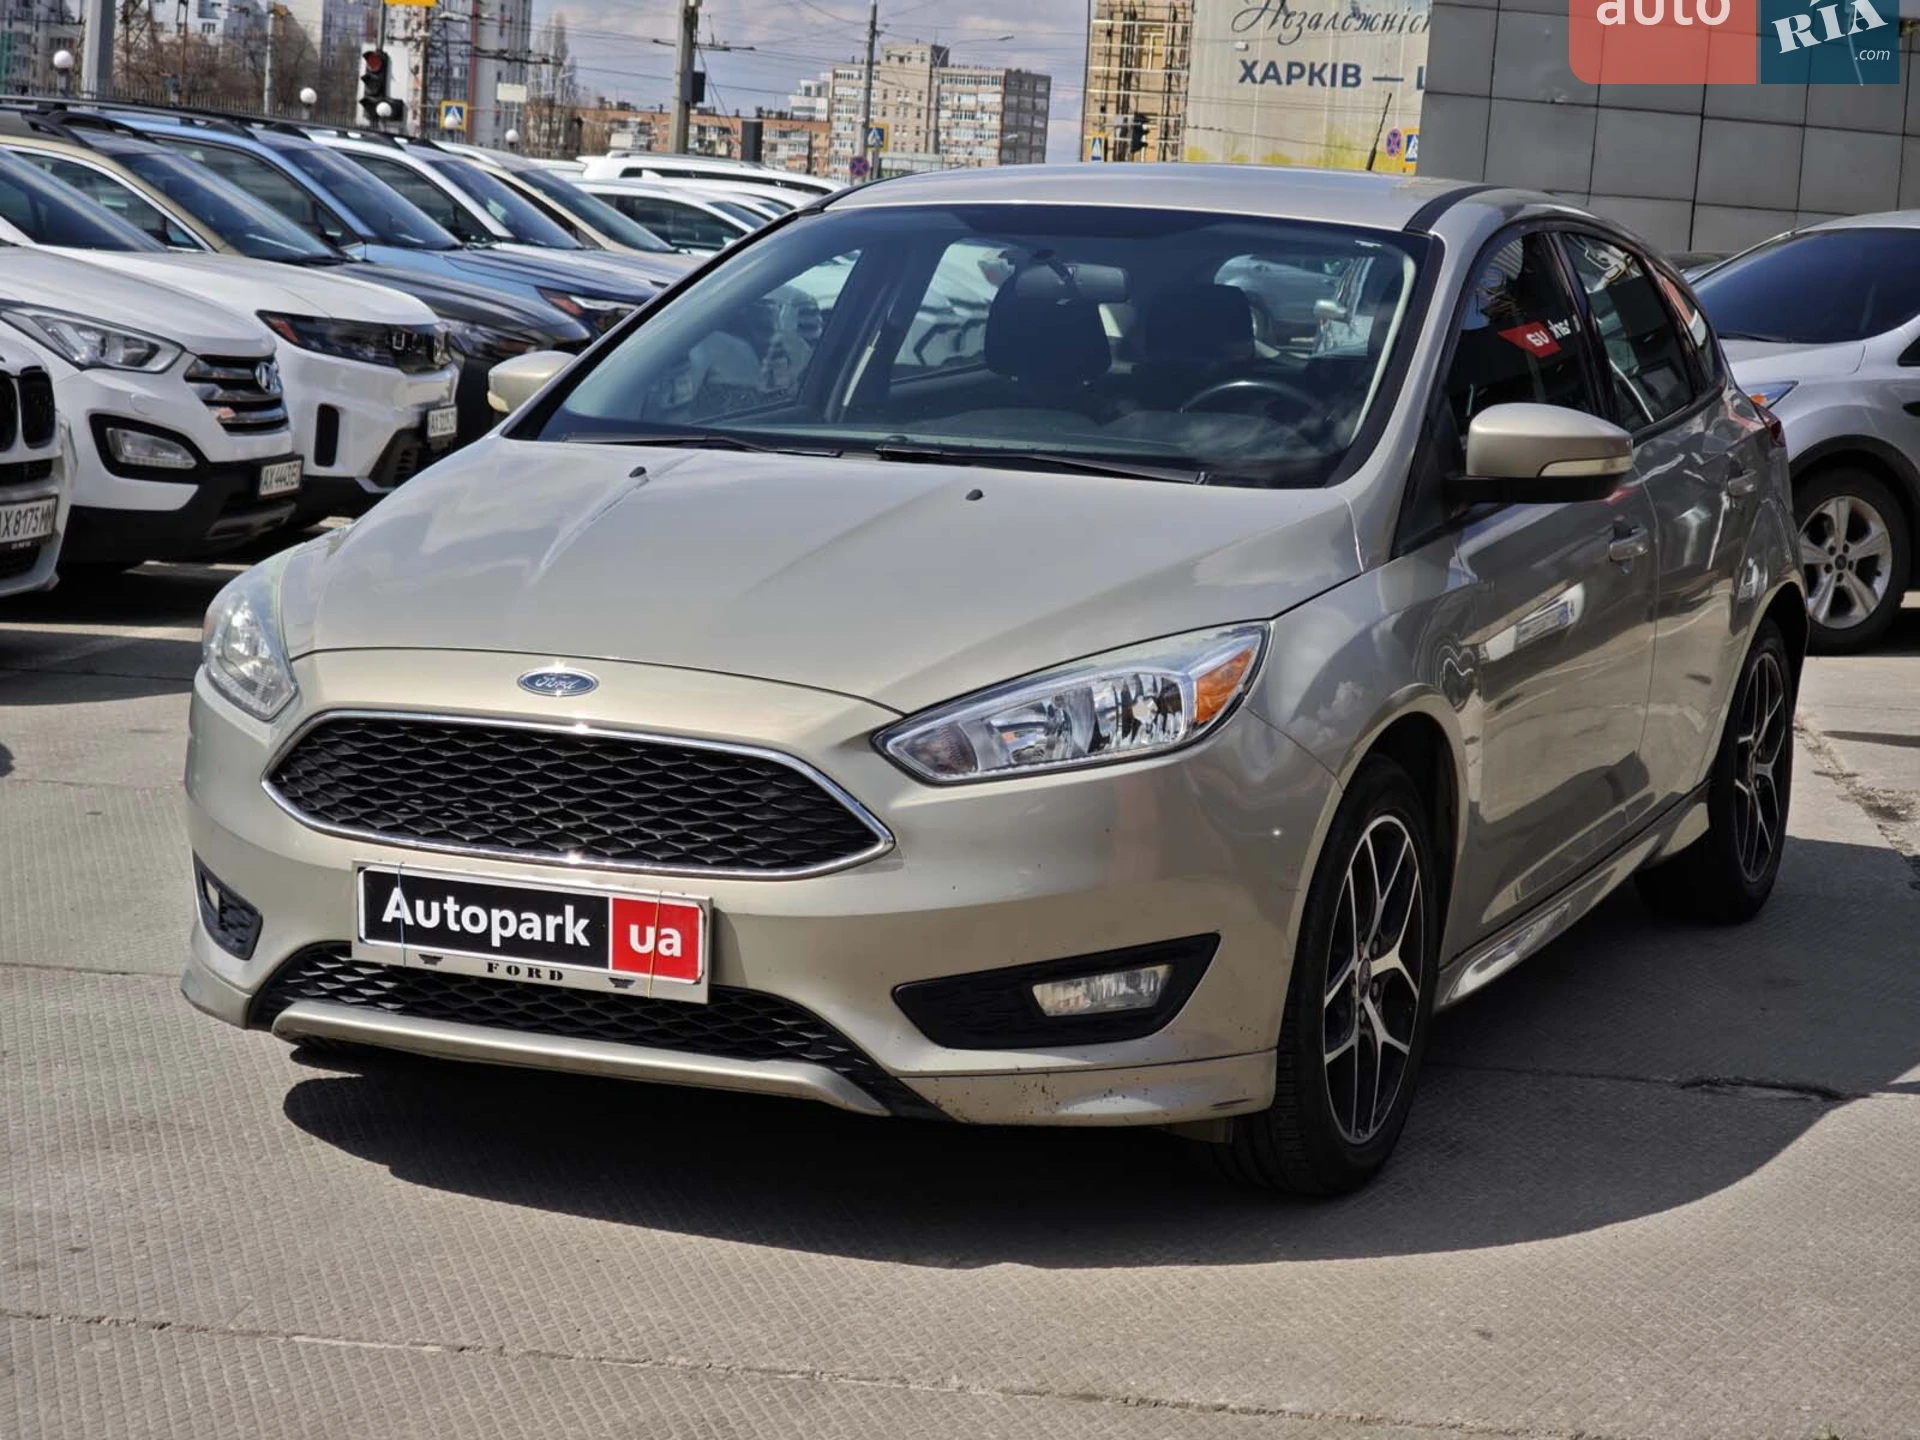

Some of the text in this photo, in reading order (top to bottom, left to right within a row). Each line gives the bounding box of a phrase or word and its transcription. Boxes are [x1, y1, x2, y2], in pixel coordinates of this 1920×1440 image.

[1238, 59, 1362, 88] ХАРКІВ
[381, 886, 683, 958] Autopark ua
[486, 961, 564, 982] FORD
